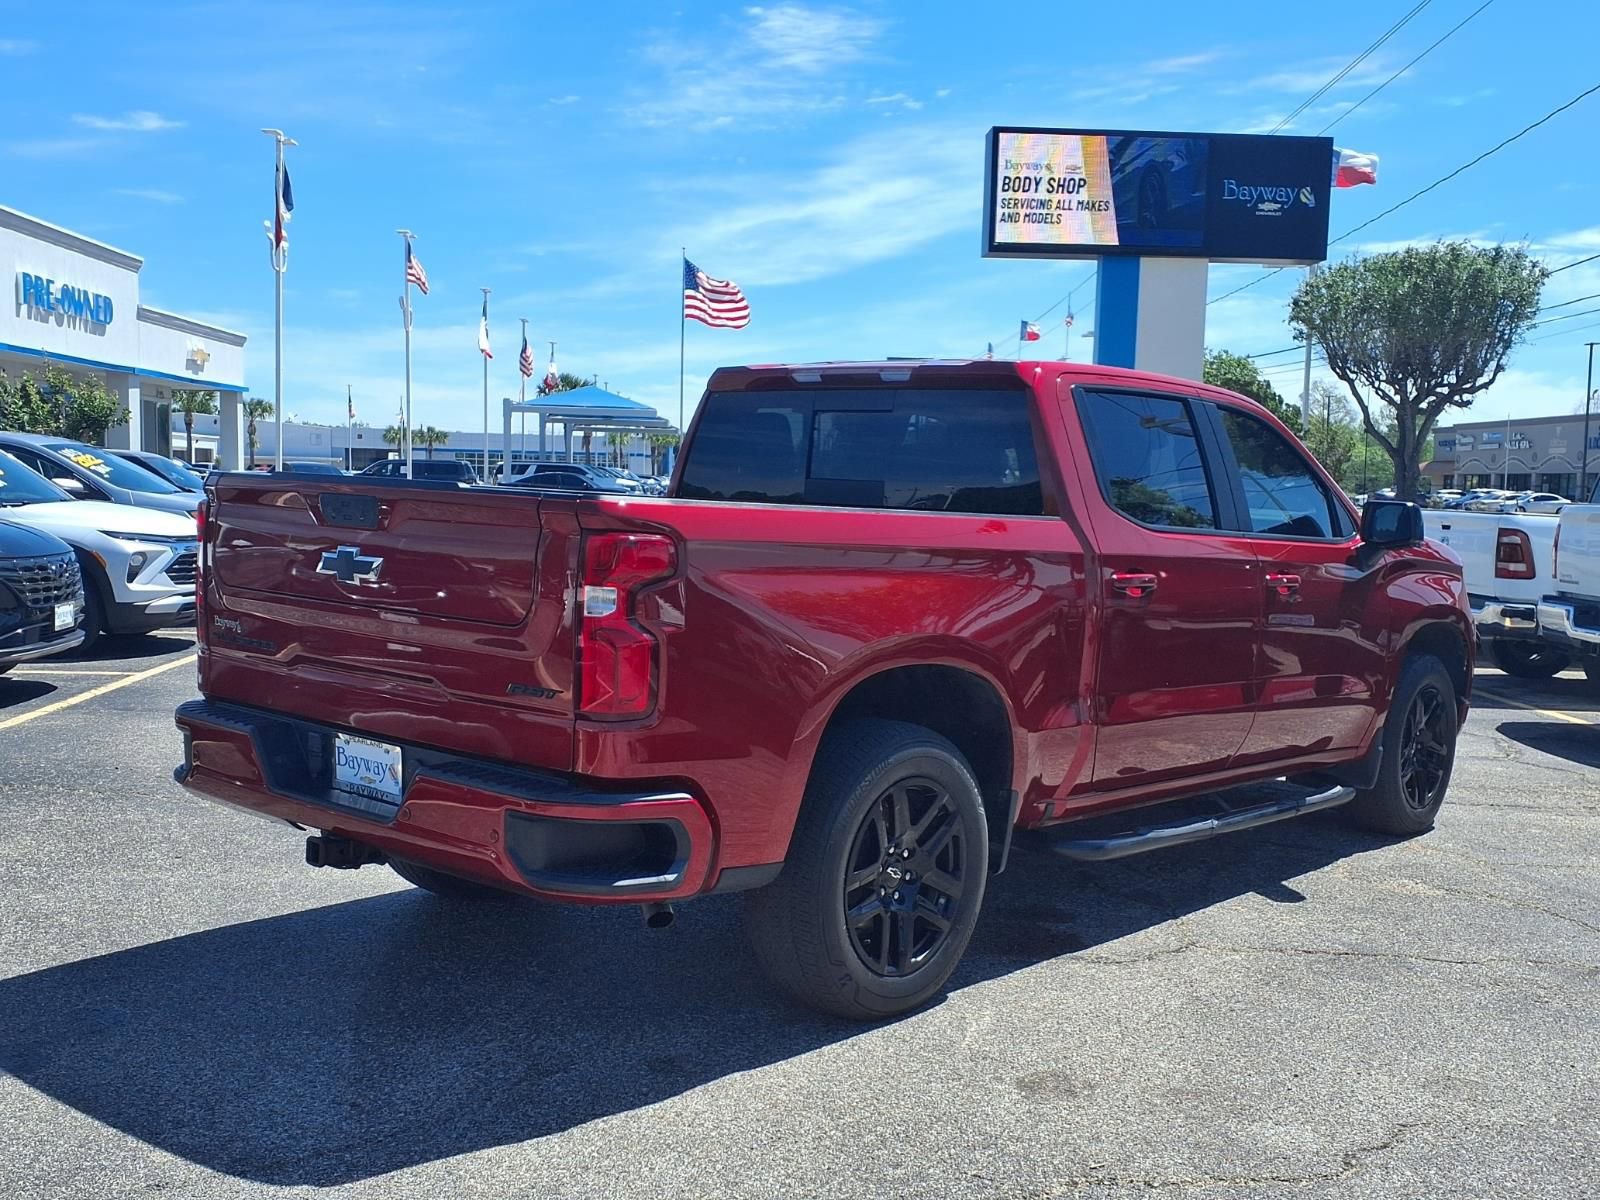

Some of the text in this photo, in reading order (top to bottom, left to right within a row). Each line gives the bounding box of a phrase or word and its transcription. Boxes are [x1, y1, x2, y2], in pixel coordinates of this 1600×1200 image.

[1004, 159, 1044, 175] Bayway
[1001, 175, 1088, 195] BODY SHOP
[1222, 179, 1298, 209] Bayway
[1000, 198, 1111, 212] SERVICING ALL MAKES
[999, 211, 1063, 225] AND MODELS
[21, 271, 114, 325] PRE-OWNED
[348, 735, 384, 749] PEARLAND
[336, 745, 388, 784] Bayway
